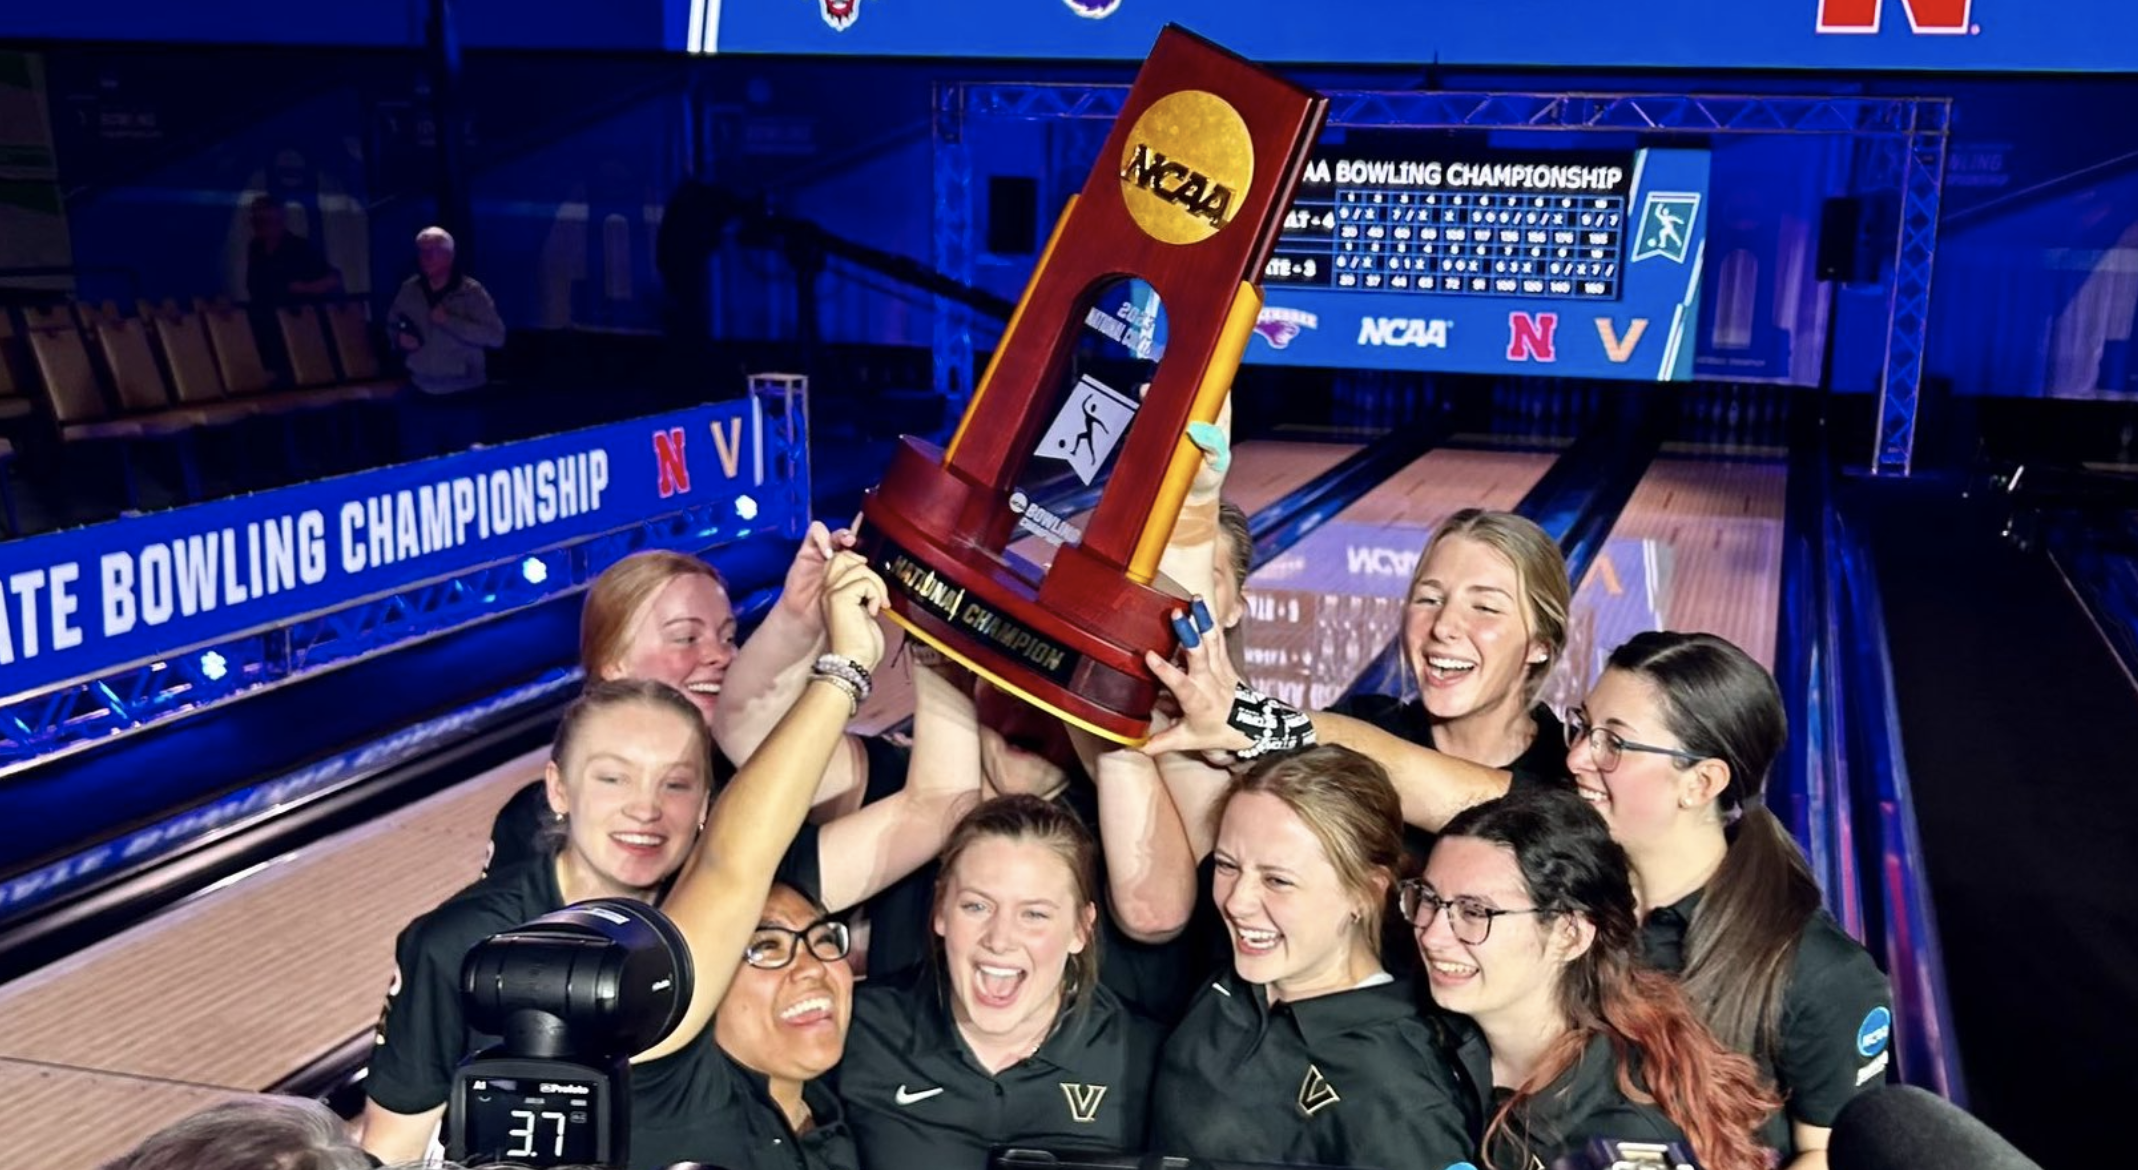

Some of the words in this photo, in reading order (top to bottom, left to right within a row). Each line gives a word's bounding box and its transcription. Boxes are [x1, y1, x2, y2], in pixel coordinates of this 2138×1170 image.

[1120, 143, 1237, 231] NCAA
[1302, 159, 1332, 183] AA
[1335, 160, 1442, 186] BOWLING
[1446, 162, 1623, 190] CHAMPIONSHIP
[1303, 259, 1316, 277] 3
[1358, 316, 1447, 348] NCAA
[1506, 311, 1558, 362] N
[1594, 318, 1648, 362] V
[653, 427, 691, 499] N
[710, 417, 742, 479] V
[101, 510, 327, 637] BOWLING
[340, 449, 609, 574] CHAMPIONSHIP
[1025, 503, 1082, 543] BOWLING
[891, 554, 966, 622] NATIONAL
[961, 602, 1066, 672] CHAMPION
[1059, 1082, 1107, 1122] V
[1299, 1064, 1341, 1117] V
[506, 1109, 566, 1157] 3.7
